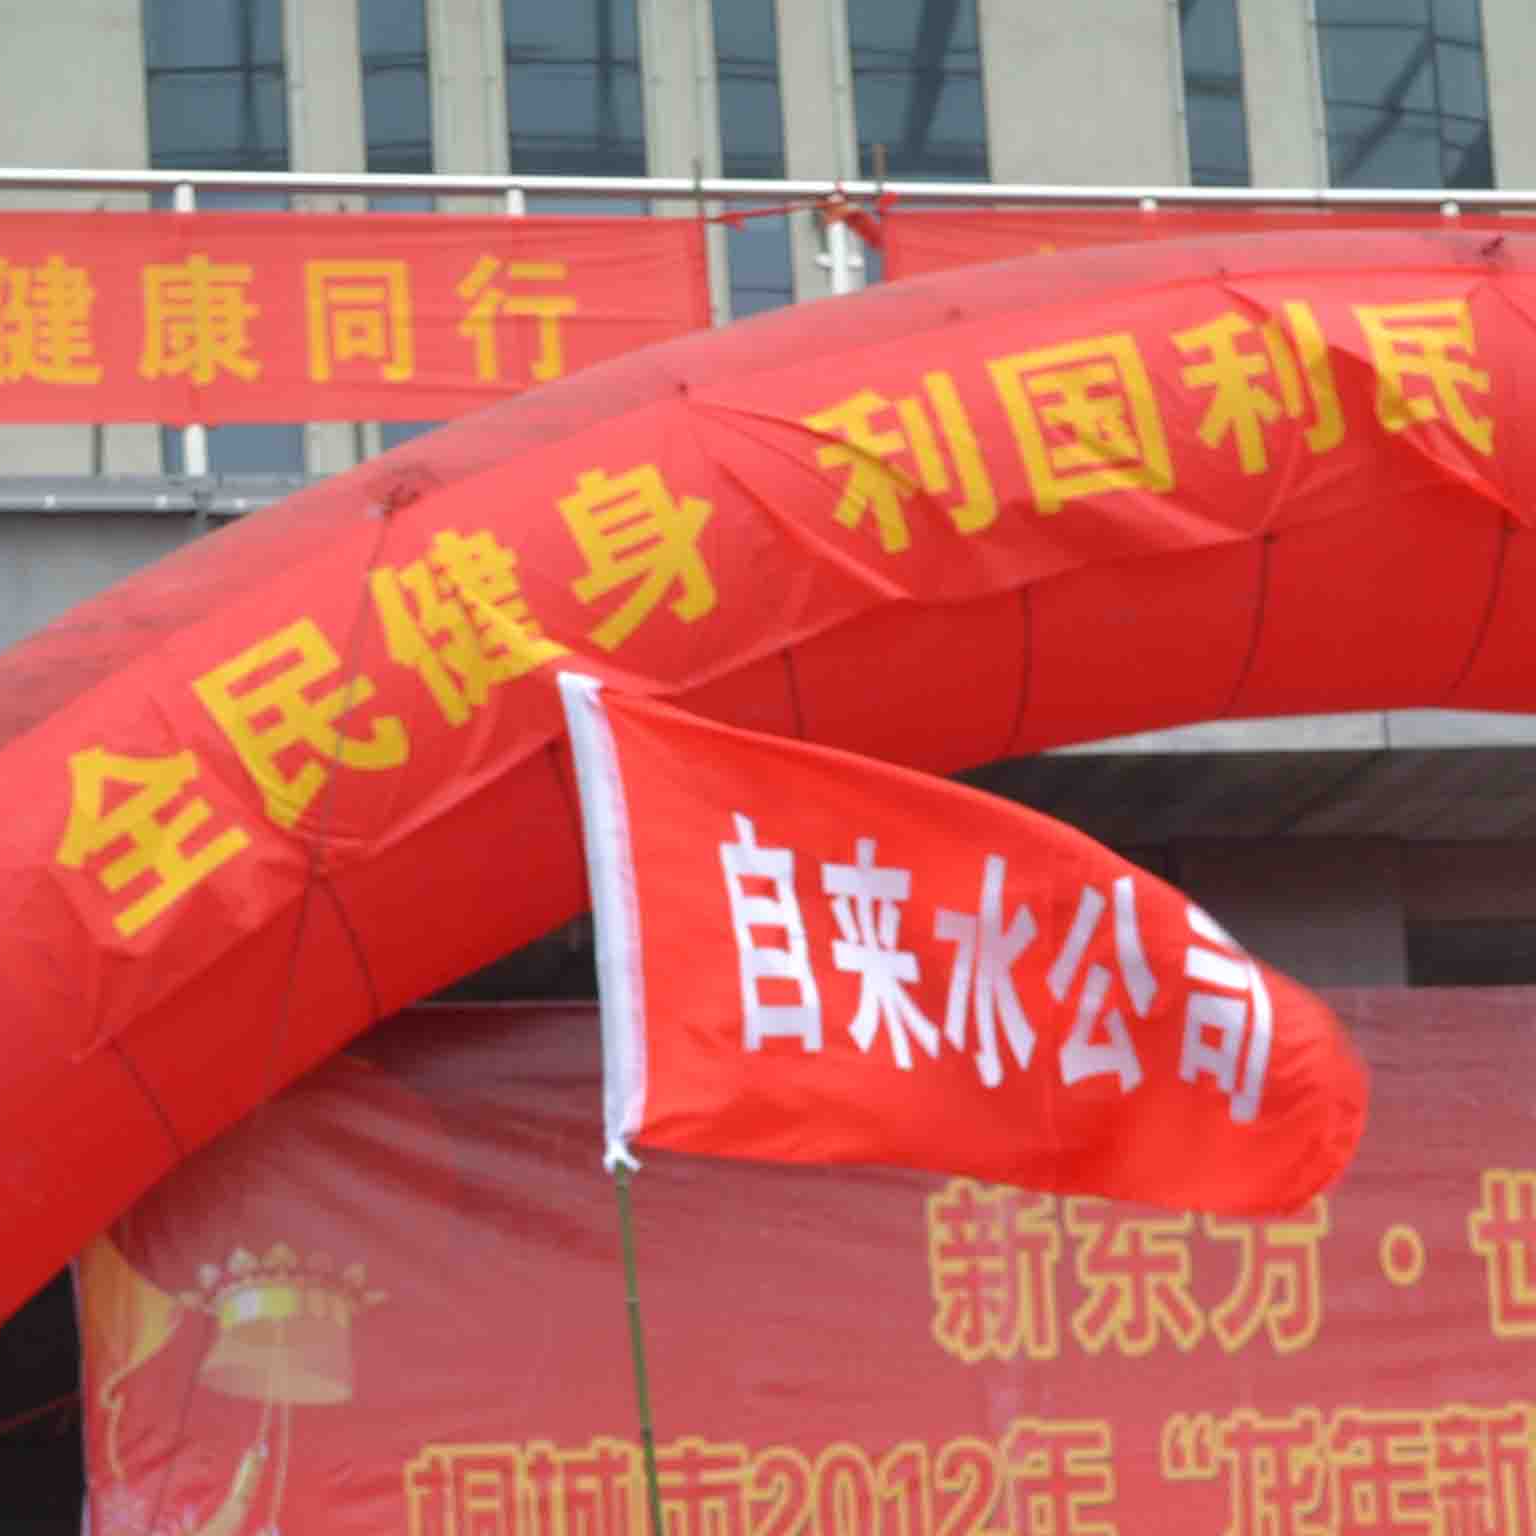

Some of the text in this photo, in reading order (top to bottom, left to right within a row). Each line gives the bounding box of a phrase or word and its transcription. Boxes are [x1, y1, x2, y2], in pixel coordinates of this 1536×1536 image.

[54, 462, 718, 938] 全民健身
[804, 299, 1495, 552] 利国利民
[719, 811, 1273, 1124] 自来水公司
